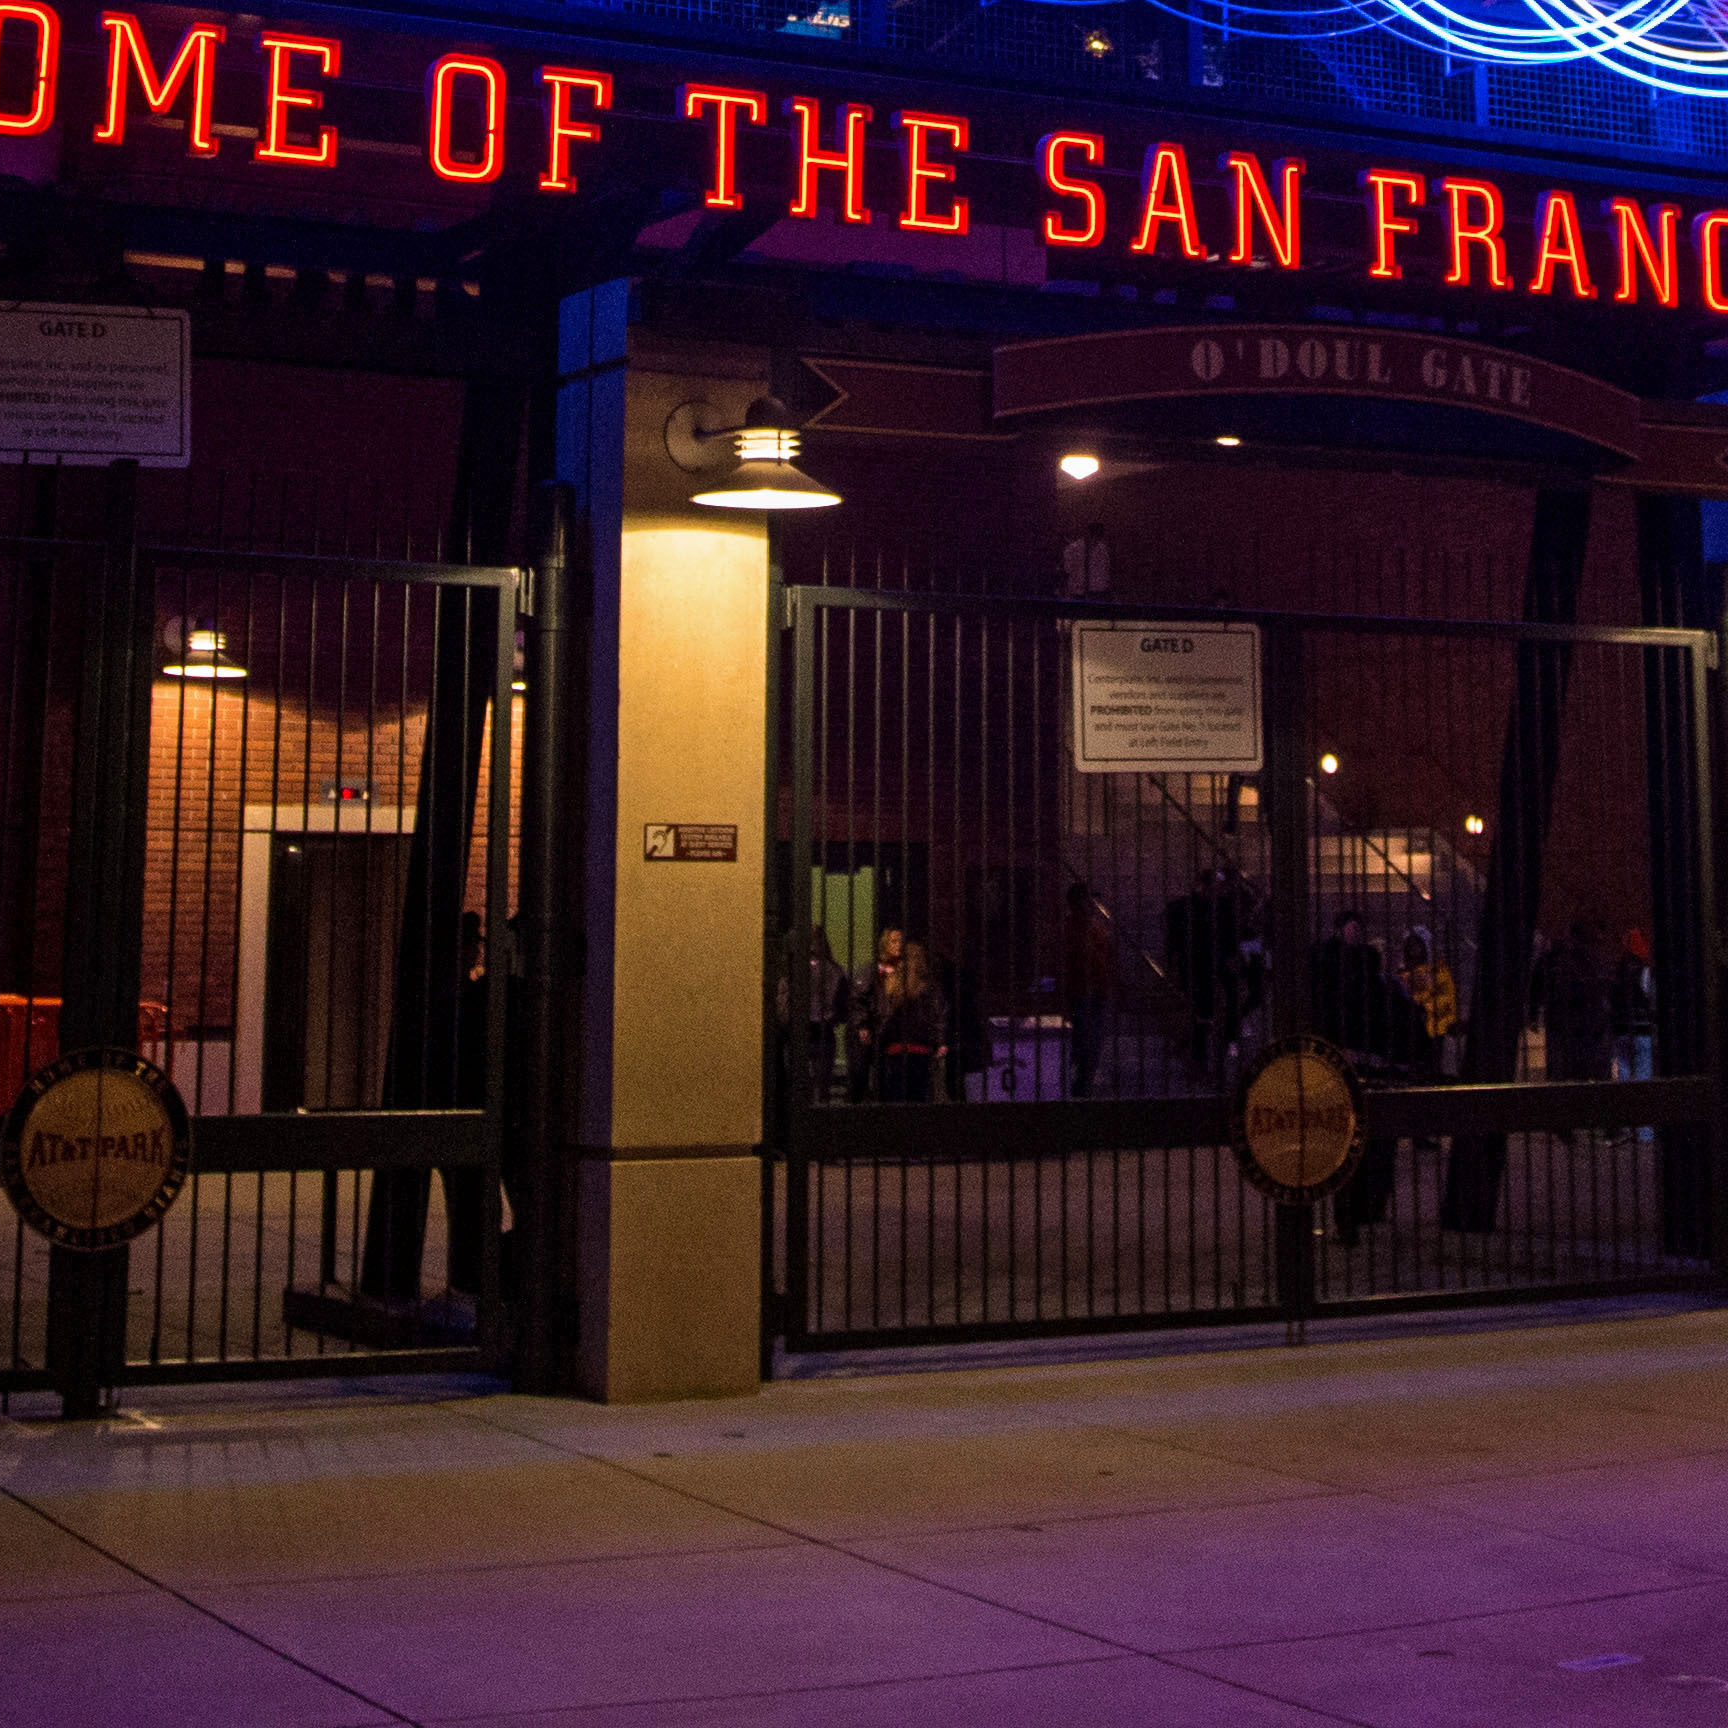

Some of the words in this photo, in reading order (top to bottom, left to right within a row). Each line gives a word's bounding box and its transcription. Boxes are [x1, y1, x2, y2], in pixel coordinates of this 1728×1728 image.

[430, 53, 612, 192] OF
[685, 83, 968, 235] THE
[1044, 131, 1299, 269] SAN
[40, 321, 87, 338] GATE
[92, 323, 107, 338] D
[1191, 339, 1392, 384] O'DOUL
[1421, 348, 1531, 406] GATE
[1140, 638, 1180, 653] GATE
[1182, 639, 1194, 653] D
[1090, 705, 1153, 715] PROHIBITED
[27, 1129, 92, 1171] AT&T
[101, 1125, 166, 1168] PARK
